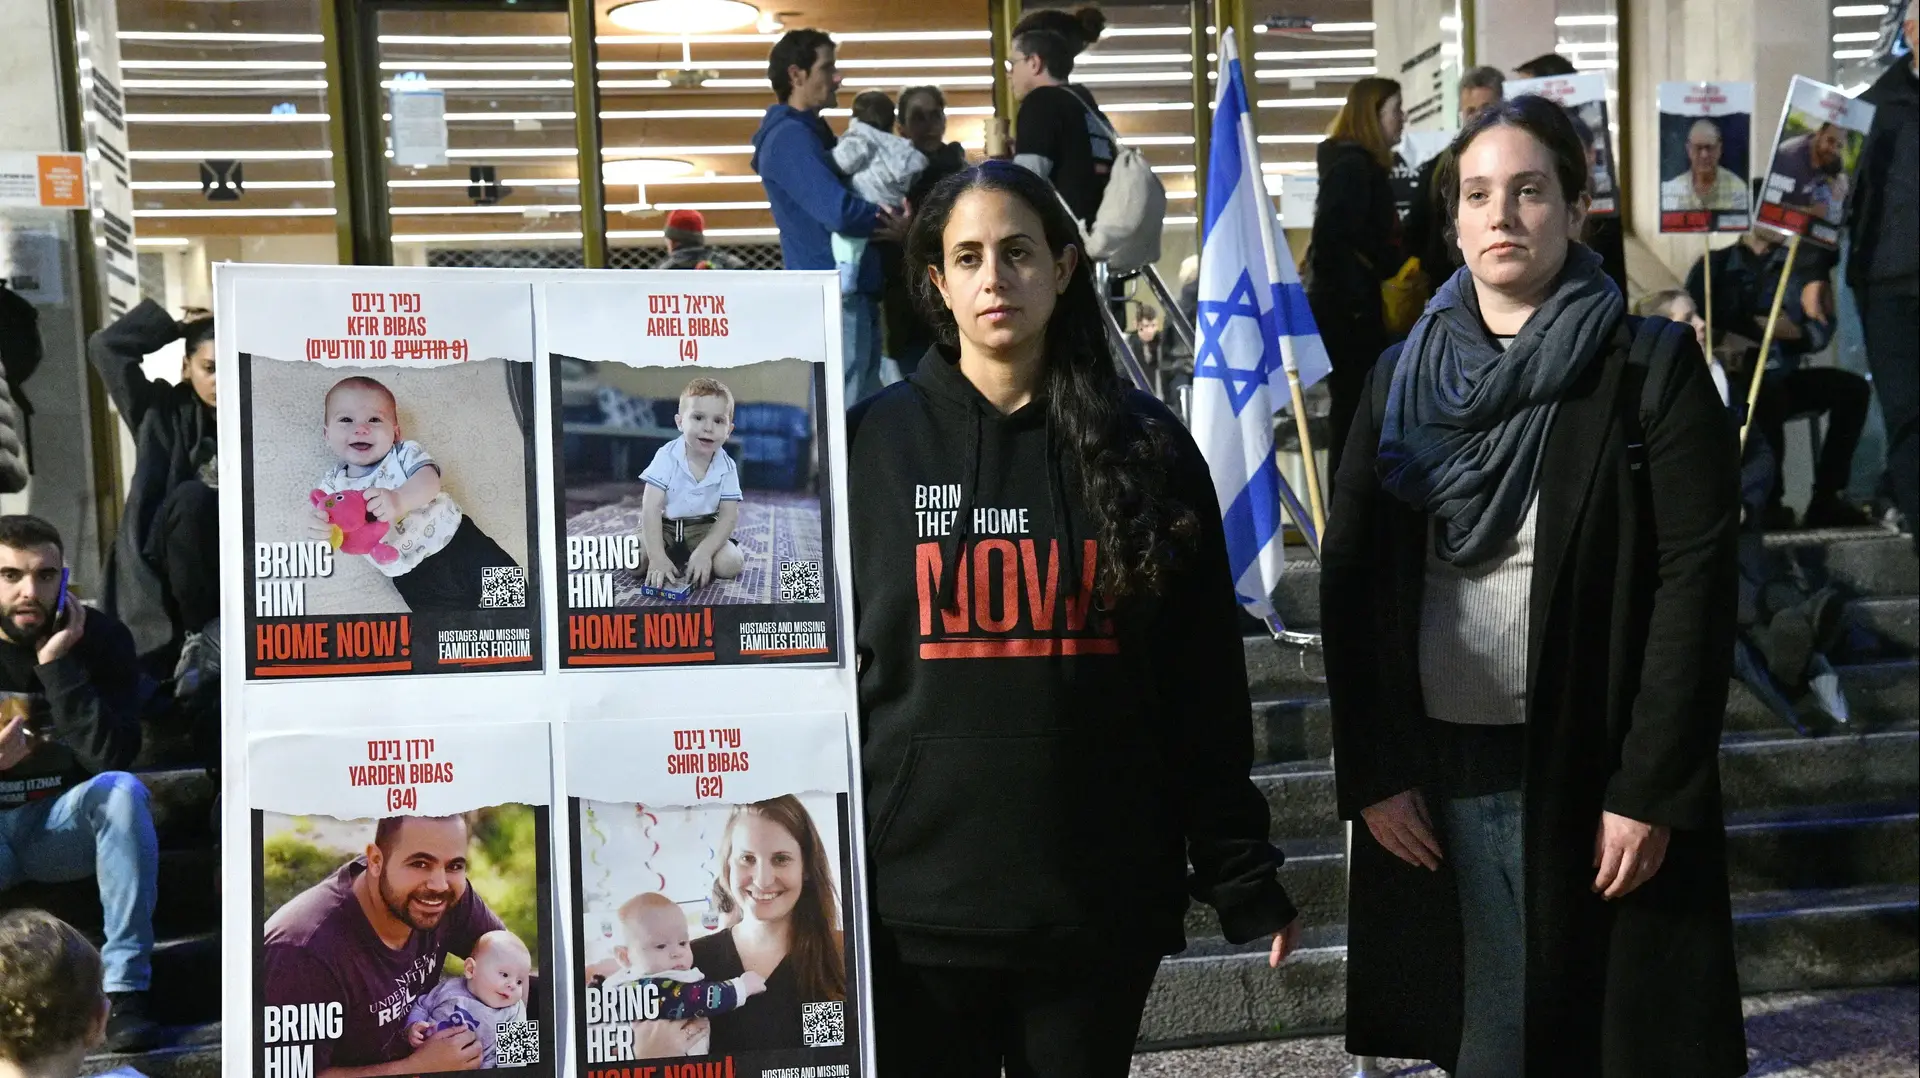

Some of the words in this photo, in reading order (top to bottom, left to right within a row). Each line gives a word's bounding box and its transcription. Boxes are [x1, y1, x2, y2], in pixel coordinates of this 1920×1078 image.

[352, 293, 384, 312] ביבס
[389, 293, 421, 313] כפיר
[648, 295, 679, 314] ביבס
[684, 294, 725, 314] אריאל
[347, 316, 379, 336] KFIR
[383, 316, 427, 336] BIBAS
[647, 318, 685, 337] ARIEL
[688, 318, 729, 337] BIBAS
[370, 340, 386, 359] 10
[679, 339, 698, 361] (4)
[915, 483, 962, 509] BRIN
[915, 511, 958, 537] THE
[973, 507, 1030, 534] HOME
[255, 540, 334, 578] BRING
[567, 535, 641, 571] BRING
[256, 581, 305, 617] HIM
[568, 573, 614, 608] HIM
[256, 622, 329, 660] HOME
[336, 615, 412, 658] NOW!
[438, 630, 478, 642] HOSTAGES
[479, 629, 495, 641] AND
[496, 628, 530, 641] MISSING
[569, 614, 638, 650] HOME
[644, 607, 714, 649] NOW!
[740, 622, 777, 634] HOSTAGES
[778, 622, 792, 633] AND
[793, 621, 826, 633] MISSING
[439, 641, 489, 660] FAMILIES
[491, 640, 530, 658] FORUM
[740, 633, 787, 650] FAMILIES
[789, 632, 826, 649] FORUM
[406, 738, 435, 762] ירדן
[673, 729, 706, 751] ביבס
[710, 728, 741, 749] שירי
[367, 740, 402, 761] ביבס
[667, 753, 704, 774] SHIRI
[708, 751, 749, 773] BIBAS
[349, 764, 406, 787] YARDEN
[409, 762, 454, 785] BIBAS
[695, 775, 723, 799] (32)
[386, 787, 418, 812] (34)
[585, 983, 660, 1024] BRING
[264, 1001, 343, 1043] BRING
[587, 1025, 635, 1064] HER
[264, 1044, 314, 1078] HIM
[761, 1067, 800, 1078] HOSTAGES
[800, 1066, 815, 1078] AND
[816, 1064, 850, 1078] MISSING
